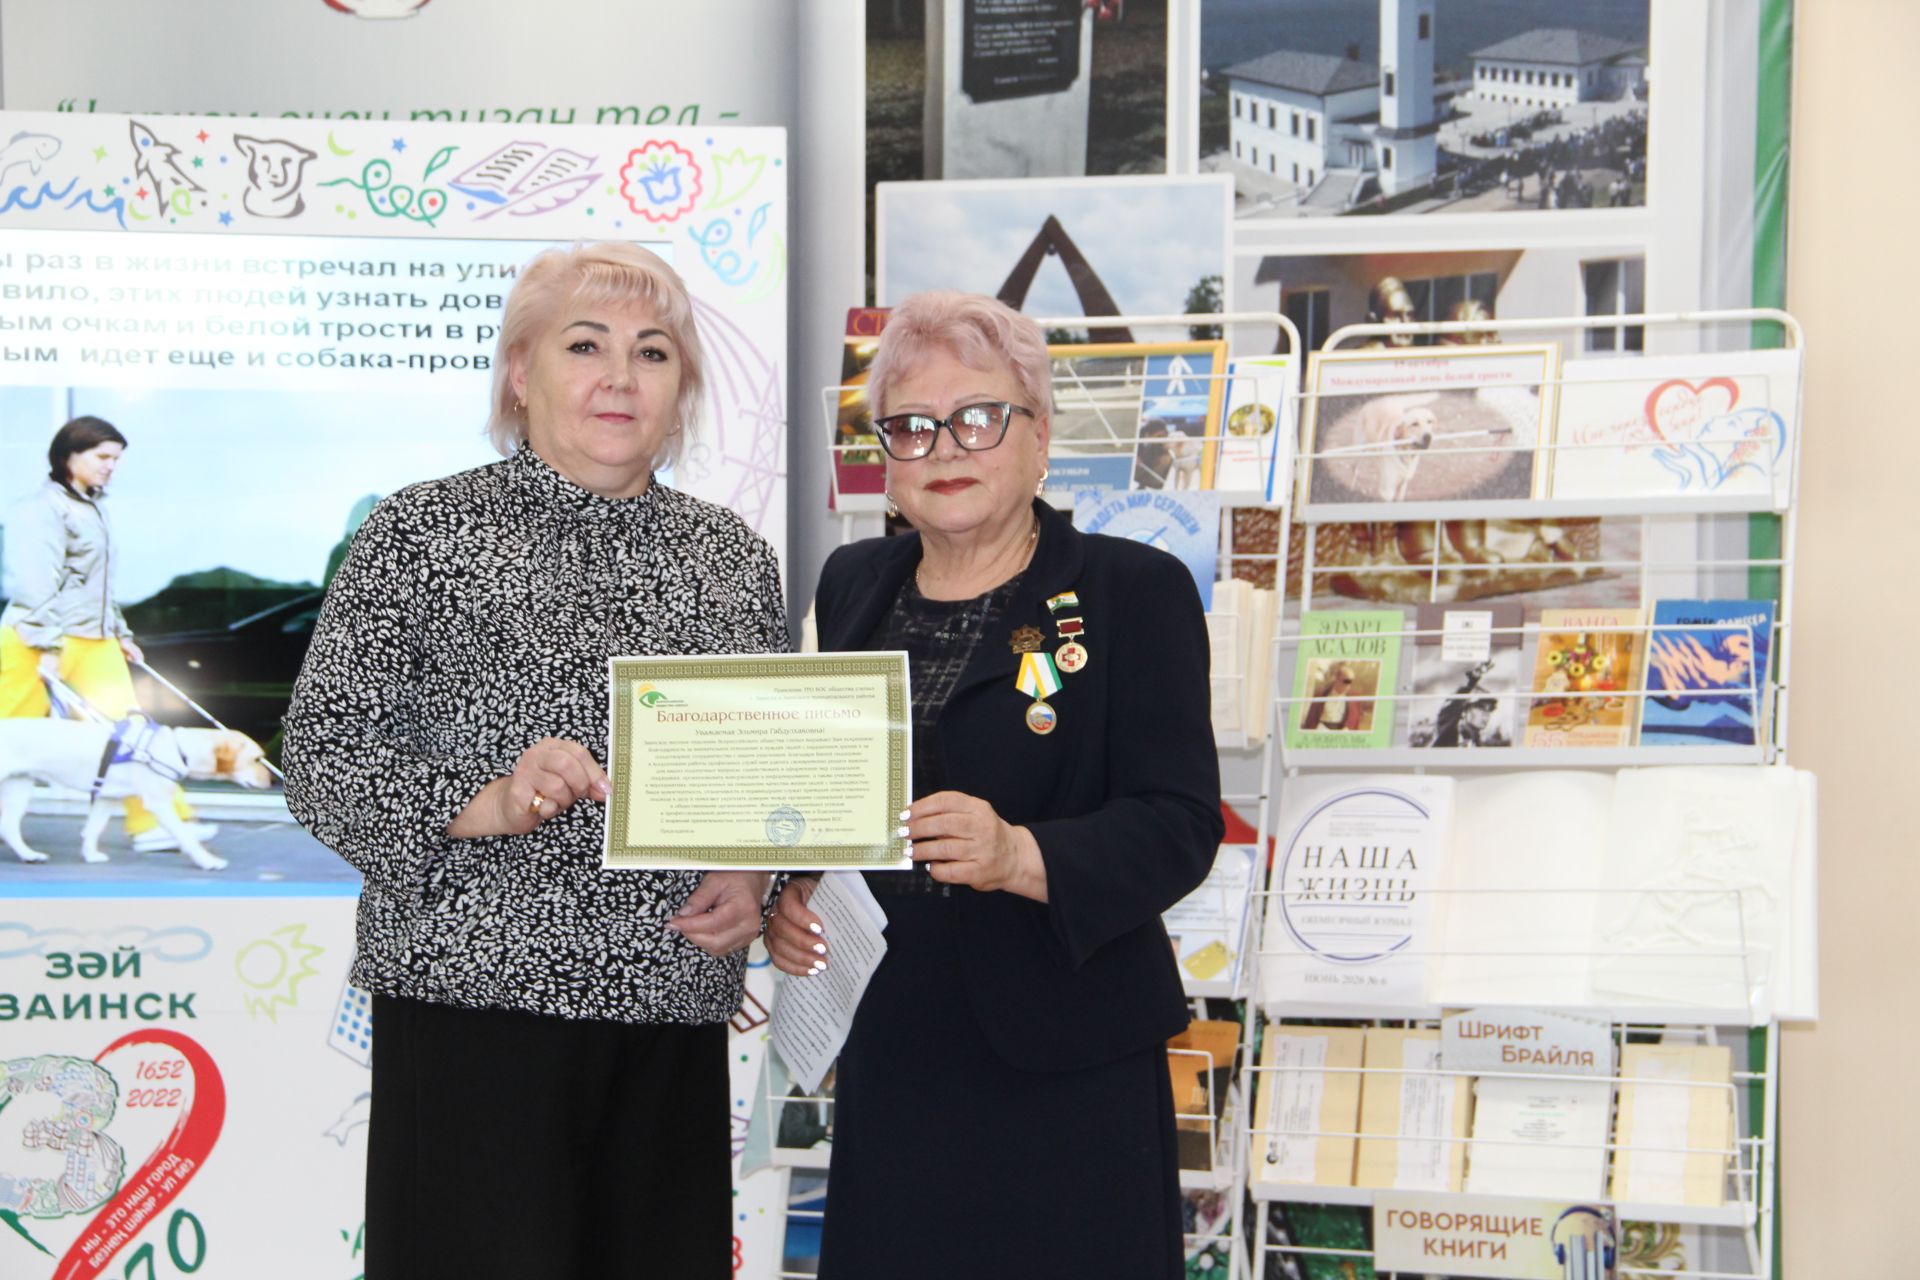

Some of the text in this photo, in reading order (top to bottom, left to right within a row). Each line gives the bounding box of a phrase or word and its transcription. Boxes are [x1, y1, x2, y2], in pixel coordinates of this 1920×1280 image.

[26, 253, 83, 273] раз
[95, 255, 115, 270] в
[126, 256, 232, 273] жизни
[243, 258, 397, 278] встречал
[409, 262, 445, 277] на
[457, 262, 526, 282] ули
[2, 284, 504, 312] вило, этих людей узнать дов
[0, 315, 501, 344] ым очкам и белой трости в р
[4, 347, 491, 374] ым идет еще и собака-пров
[656, 708, 862, 725] Благодарственное письмо
[695, 728, 735, 737] Уважаемая
[1302, 846, 1418, 871] НАША
[1297, 877, 1416, 902] ЖИЗНЬ
[45, 946, 142, 980] ЗӘЙ
[0, 992, 198, 1021] ЗАИНСК
[1458, 1021, 1544, 1041] ШРИФТ
[1501, 1045, 1595, 1067] БРАЙЛЯ
[135, 1060, 185, 1080] 1652
[125, 1087, 183, 1108] 2022
[160, 1176, 178, 1194] УЛ
[81, 1233, 103, 1255] МЫ
[105, 1208, 128, 1230] ЭТО
[124, 1185, 150, 1211] НАШ
[145, 1153, 182, 1188] ГОРОД
[1386, 1209, 1544, 1237] ГОВОРЯЩИЕ
[1423, 1237, 1508, 1261] КНИГИ
